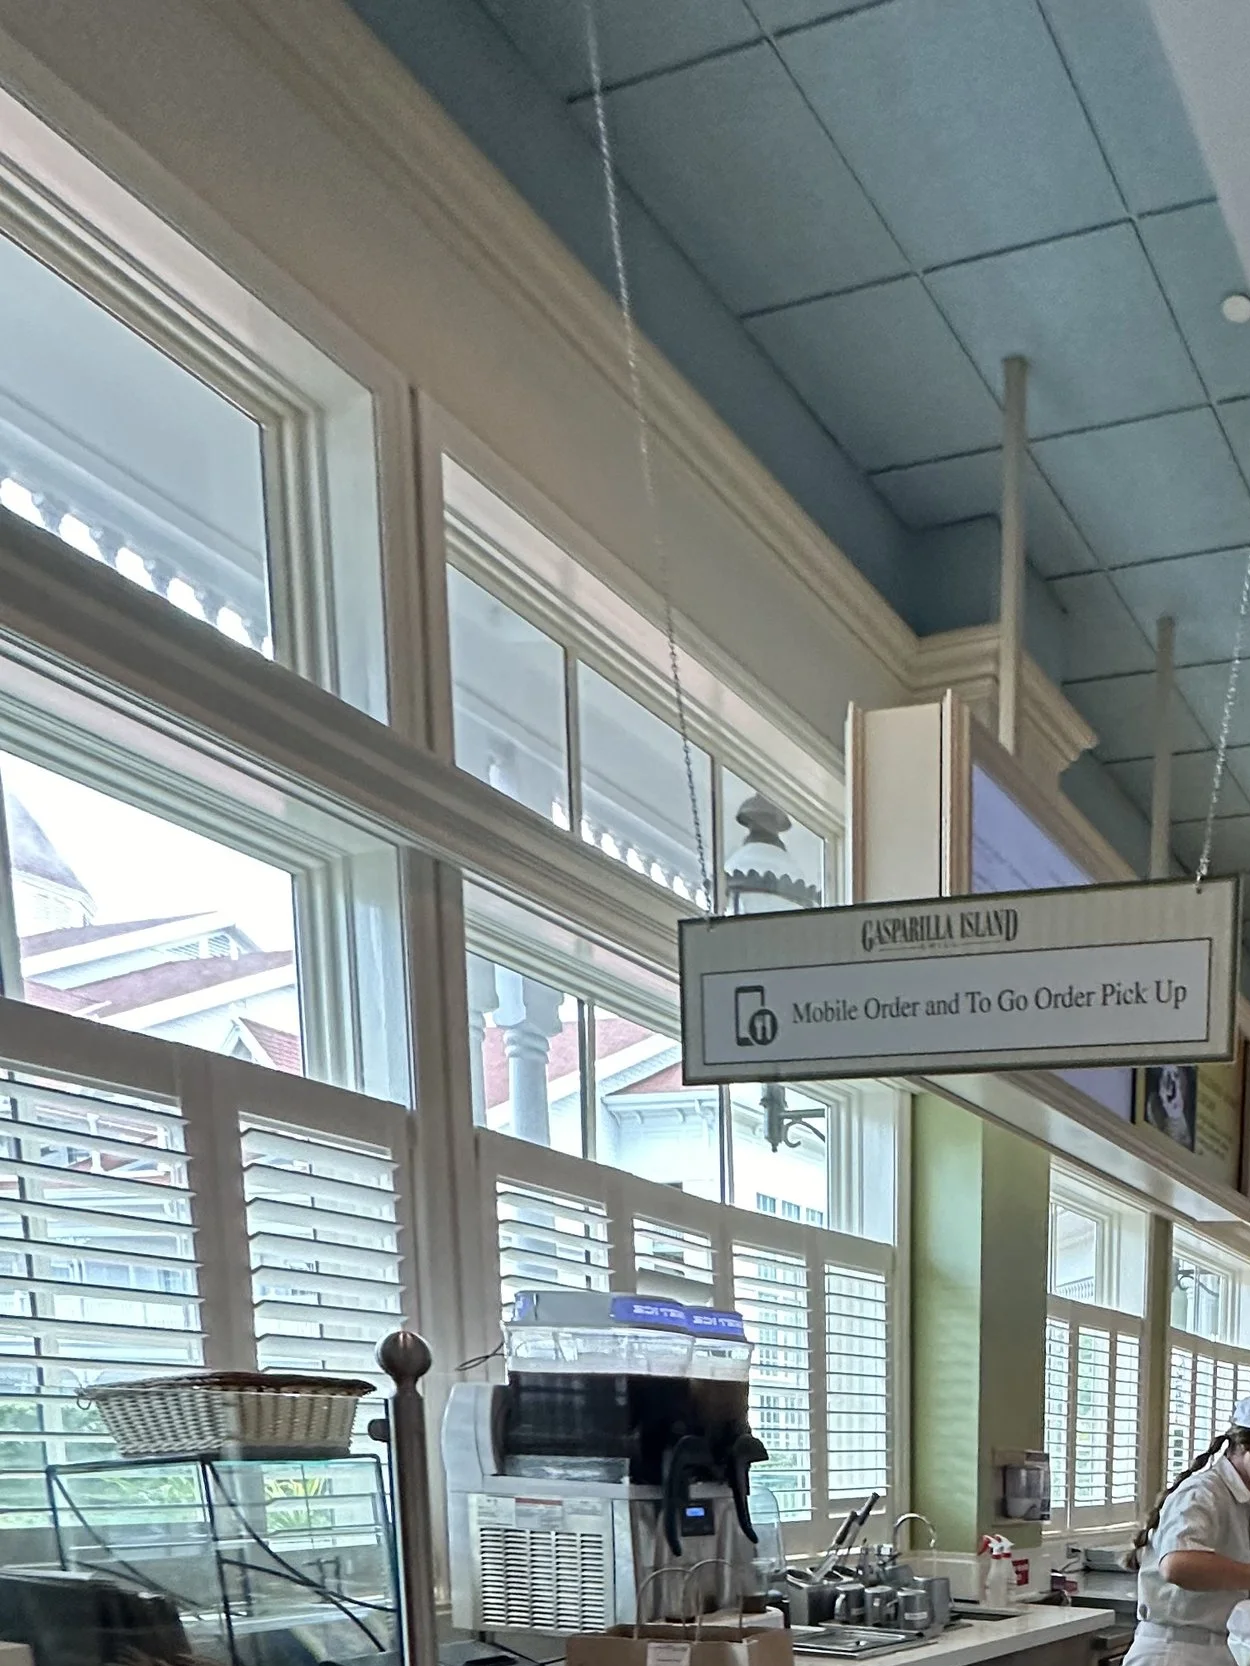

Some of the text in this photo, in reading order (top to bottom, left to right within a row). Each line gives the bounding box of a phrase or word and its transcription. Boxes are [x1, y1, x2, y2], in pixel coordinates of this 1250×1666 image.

[861, 909, 1018, 951] GASPARILLA ISLAND
[792, 979, 1187, 1024] Mobile Order and To Go Order Pick Up
